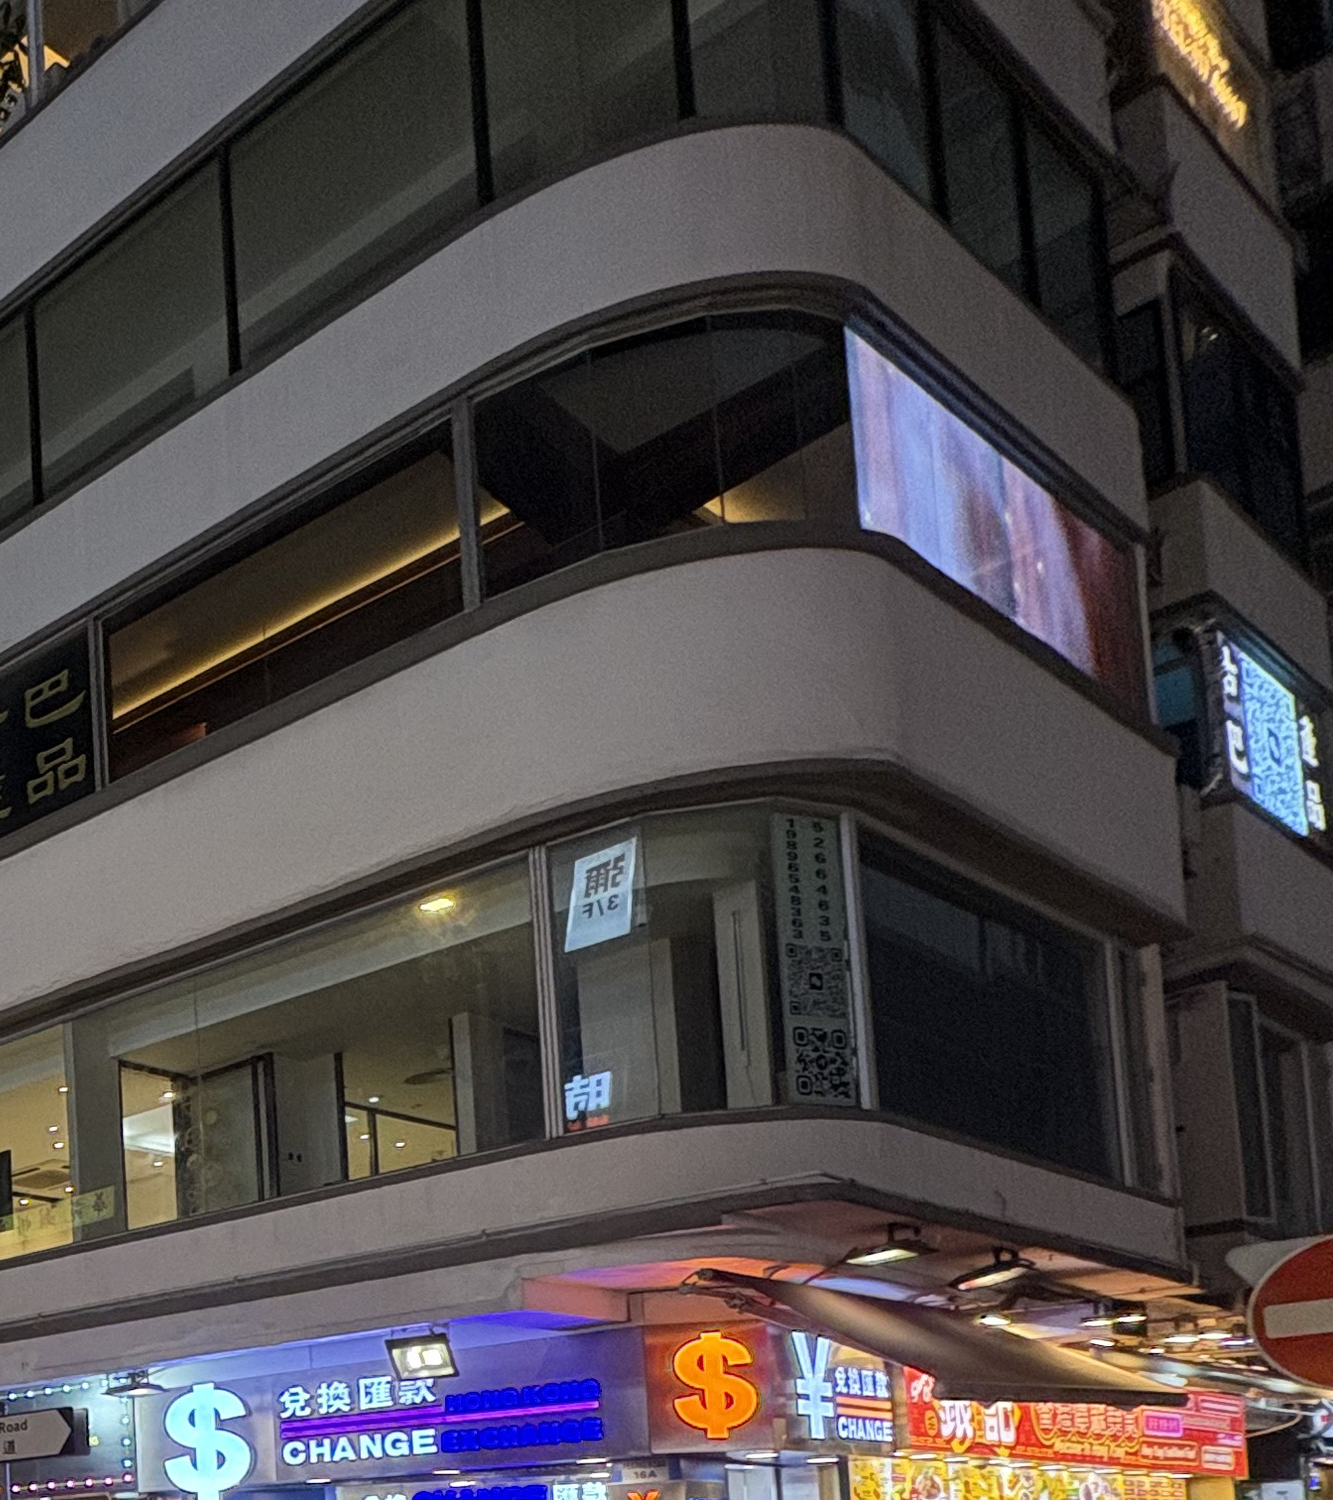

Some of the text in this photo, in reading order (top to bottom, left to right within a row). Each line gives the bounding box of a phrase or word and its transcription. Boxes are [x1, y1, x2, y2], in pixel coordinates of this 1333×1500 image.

[444, 1378, 602, 1413] HONG KONG
[281, 1428, 439, 1466] CHANGE
[440, 1417, 604, 1454] EXCHANGE
[837, 1416, 894, 1443] CHANGE
[634, 1470, 657, 1480] 16A
